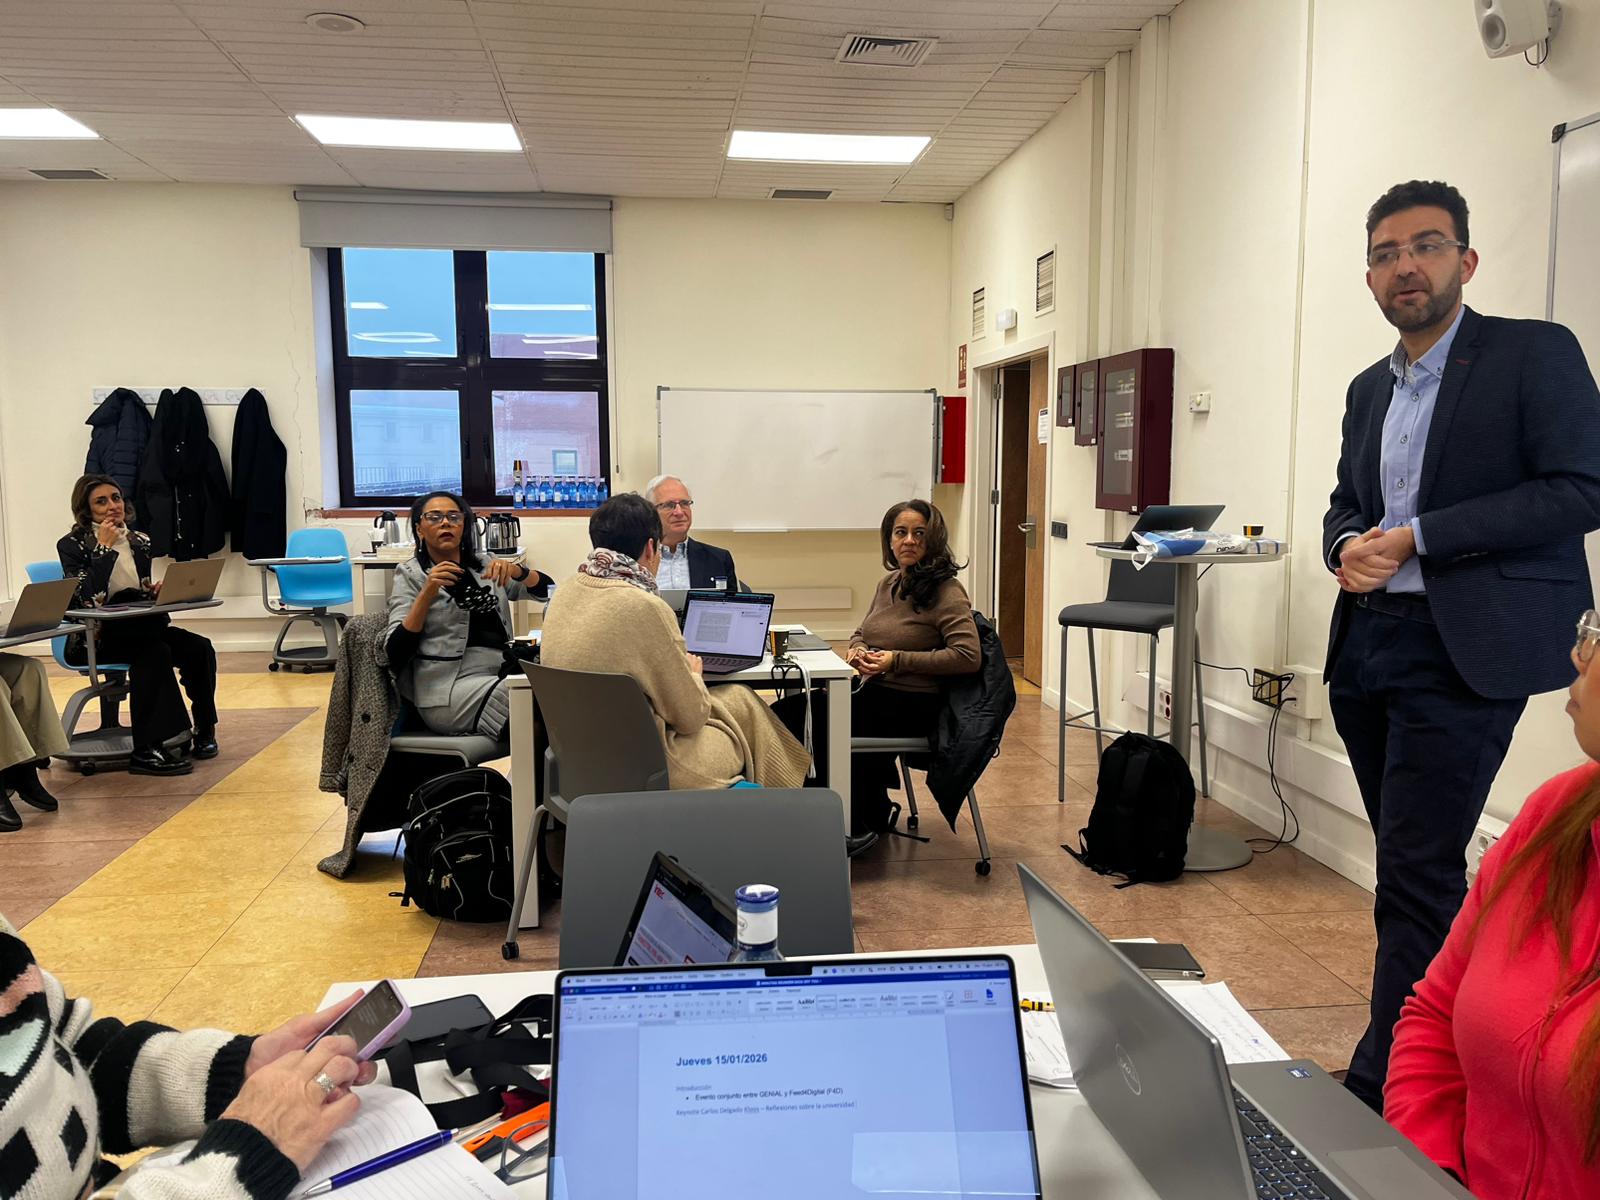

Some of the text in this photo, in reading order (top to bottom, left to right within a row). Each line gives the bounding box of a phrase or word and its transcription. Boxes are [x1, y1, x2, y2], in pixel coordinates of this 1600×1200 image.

[676, 1053, 768, 1067] Jueves 15/01/2026
[717, 1092, 741, 1101] conjunto
[760, 1090, 782, 1098] GENIAL
[827, 1087, 844, 1095] (F4D)
[701, 1107, 719, 1115] Carlos
[720, 1107, 742, 1115] Delgado
[799, 1102, 815, 1110] sobre
[822, 1101, 855, 1109] universidad
